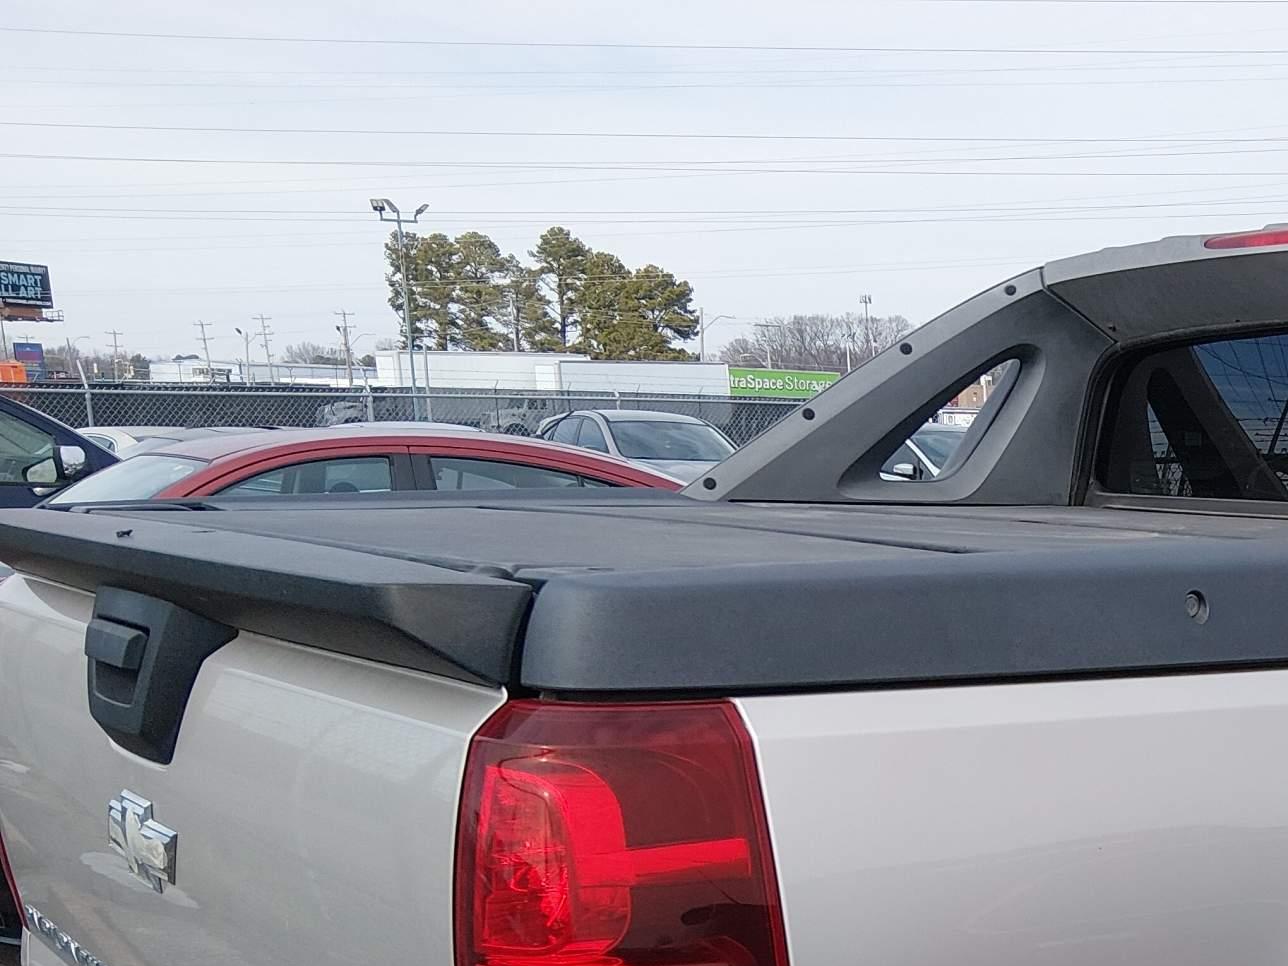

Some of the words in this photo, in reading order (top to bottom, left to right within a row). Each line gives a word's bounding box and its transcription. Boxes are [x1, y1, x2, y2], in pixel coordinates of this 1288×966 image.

[0, 271, 42, 288] SMART
[20, 286, 42, 299] ART
[729, 374, 784, 392] traSpace
